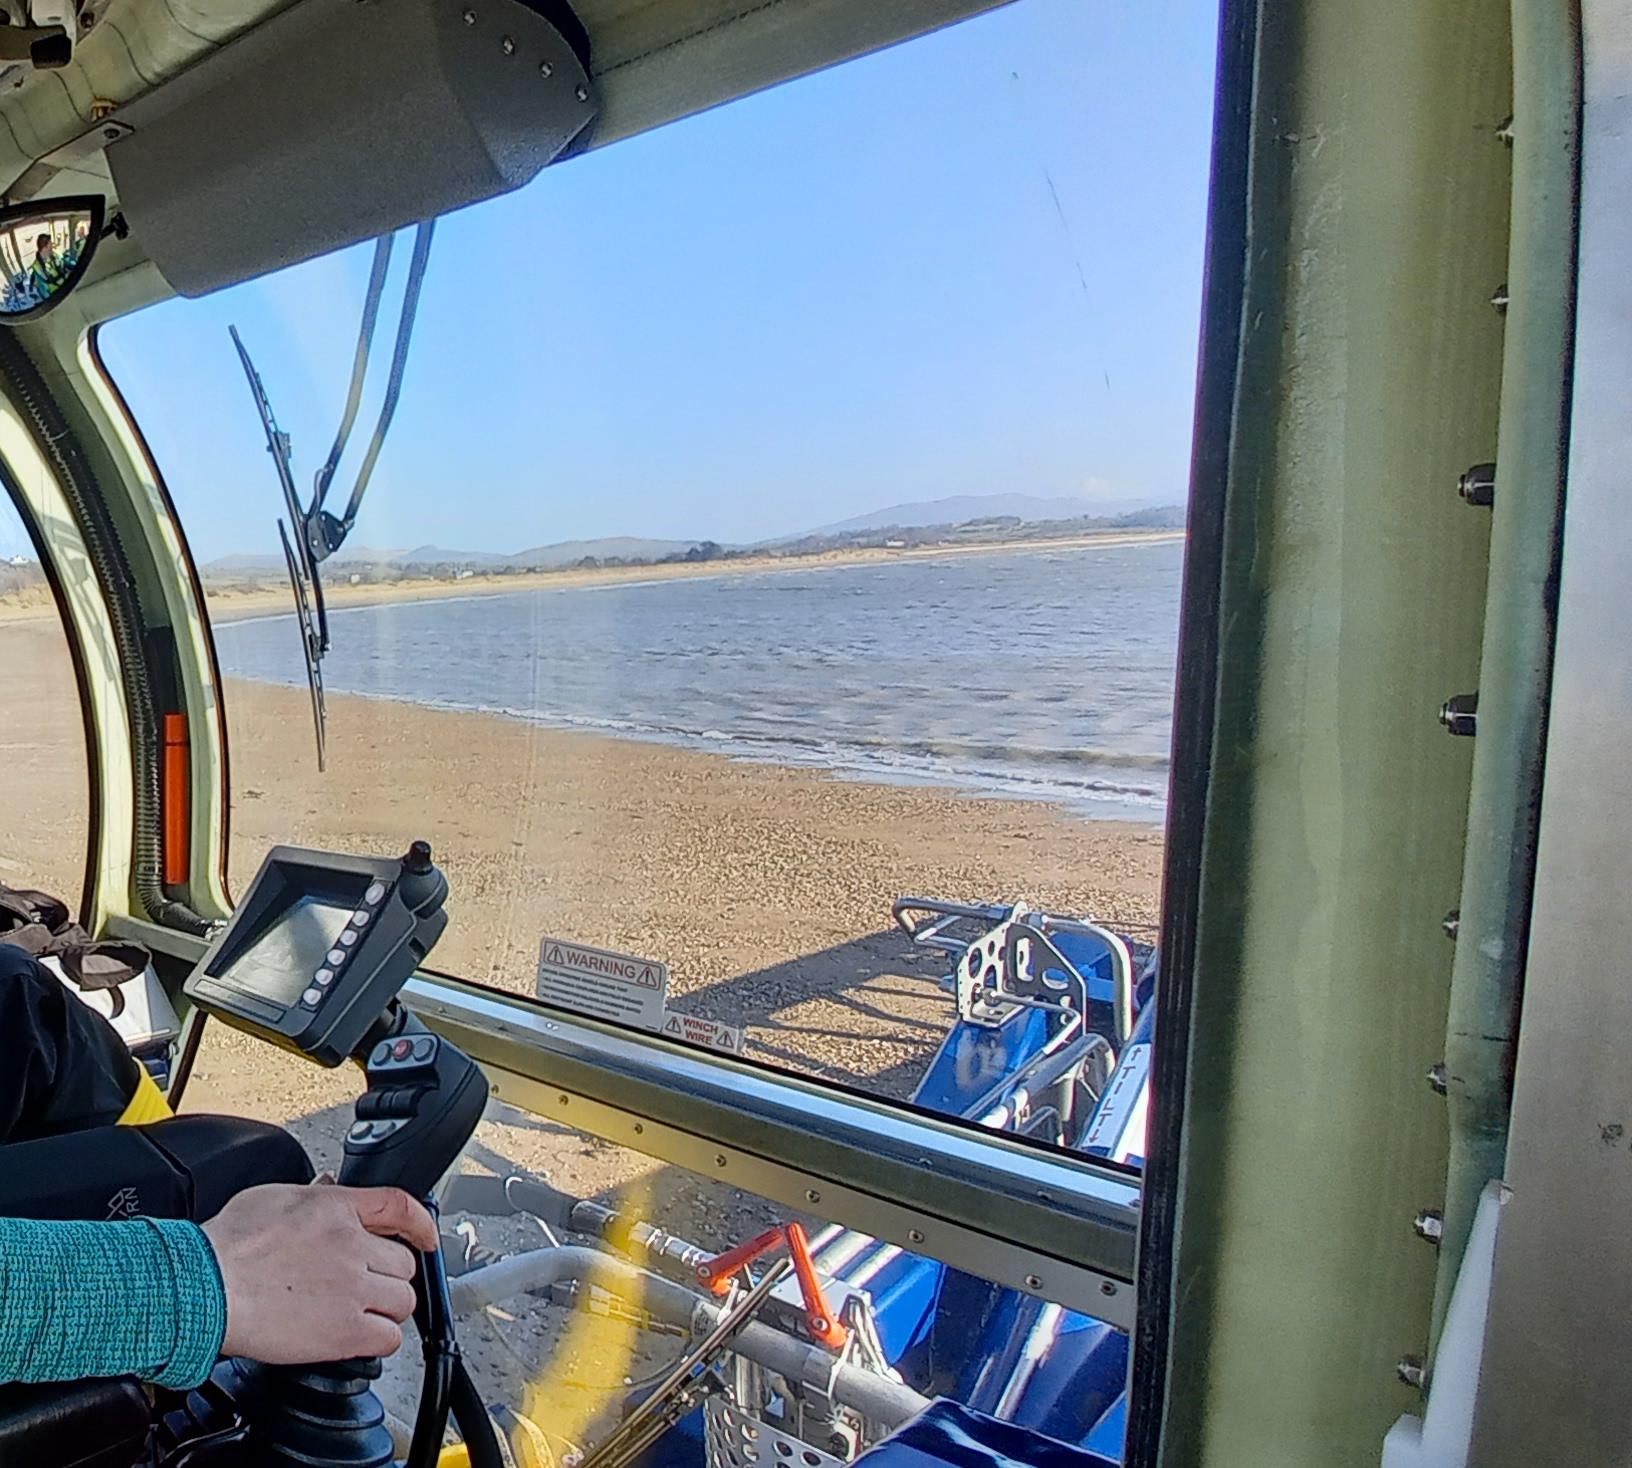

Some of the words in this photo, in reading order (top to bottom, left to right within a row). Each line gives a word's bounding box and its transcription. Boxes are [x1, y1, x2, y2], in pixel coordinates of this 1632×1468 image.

[566, 951, 636, 979] WARNING
[683, 1017, 719, 1035] WINCH
[685, 1029, 714, 1045] WIRE
[1098, 1066, 1136, 1126] TILT
